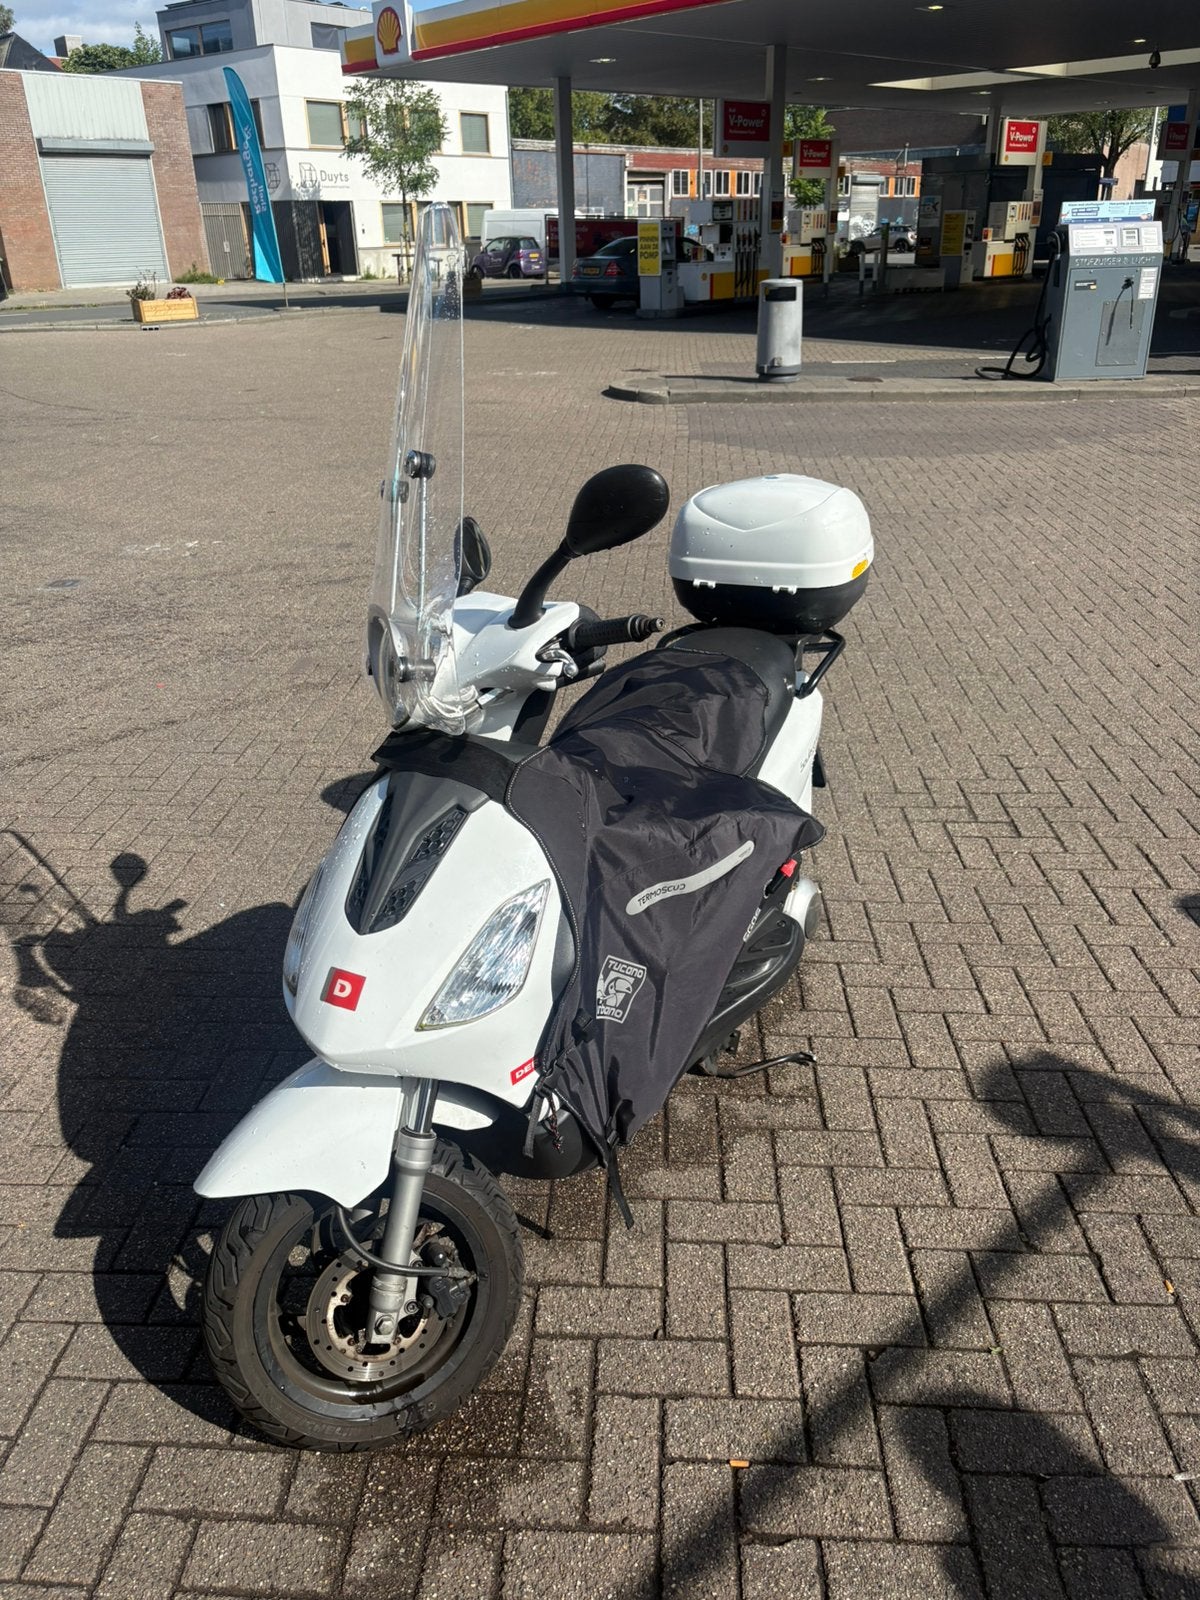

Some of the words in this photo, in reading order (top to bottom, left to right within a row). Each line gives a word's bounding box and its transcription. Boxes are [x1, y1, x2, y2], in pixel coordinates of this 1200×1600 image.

[728, 114, 764, 128] V-Power
[320, 170, 350, 184] Duyts
[639, 250, 659, 260] POMP
[333, 978, 352, 999] D
